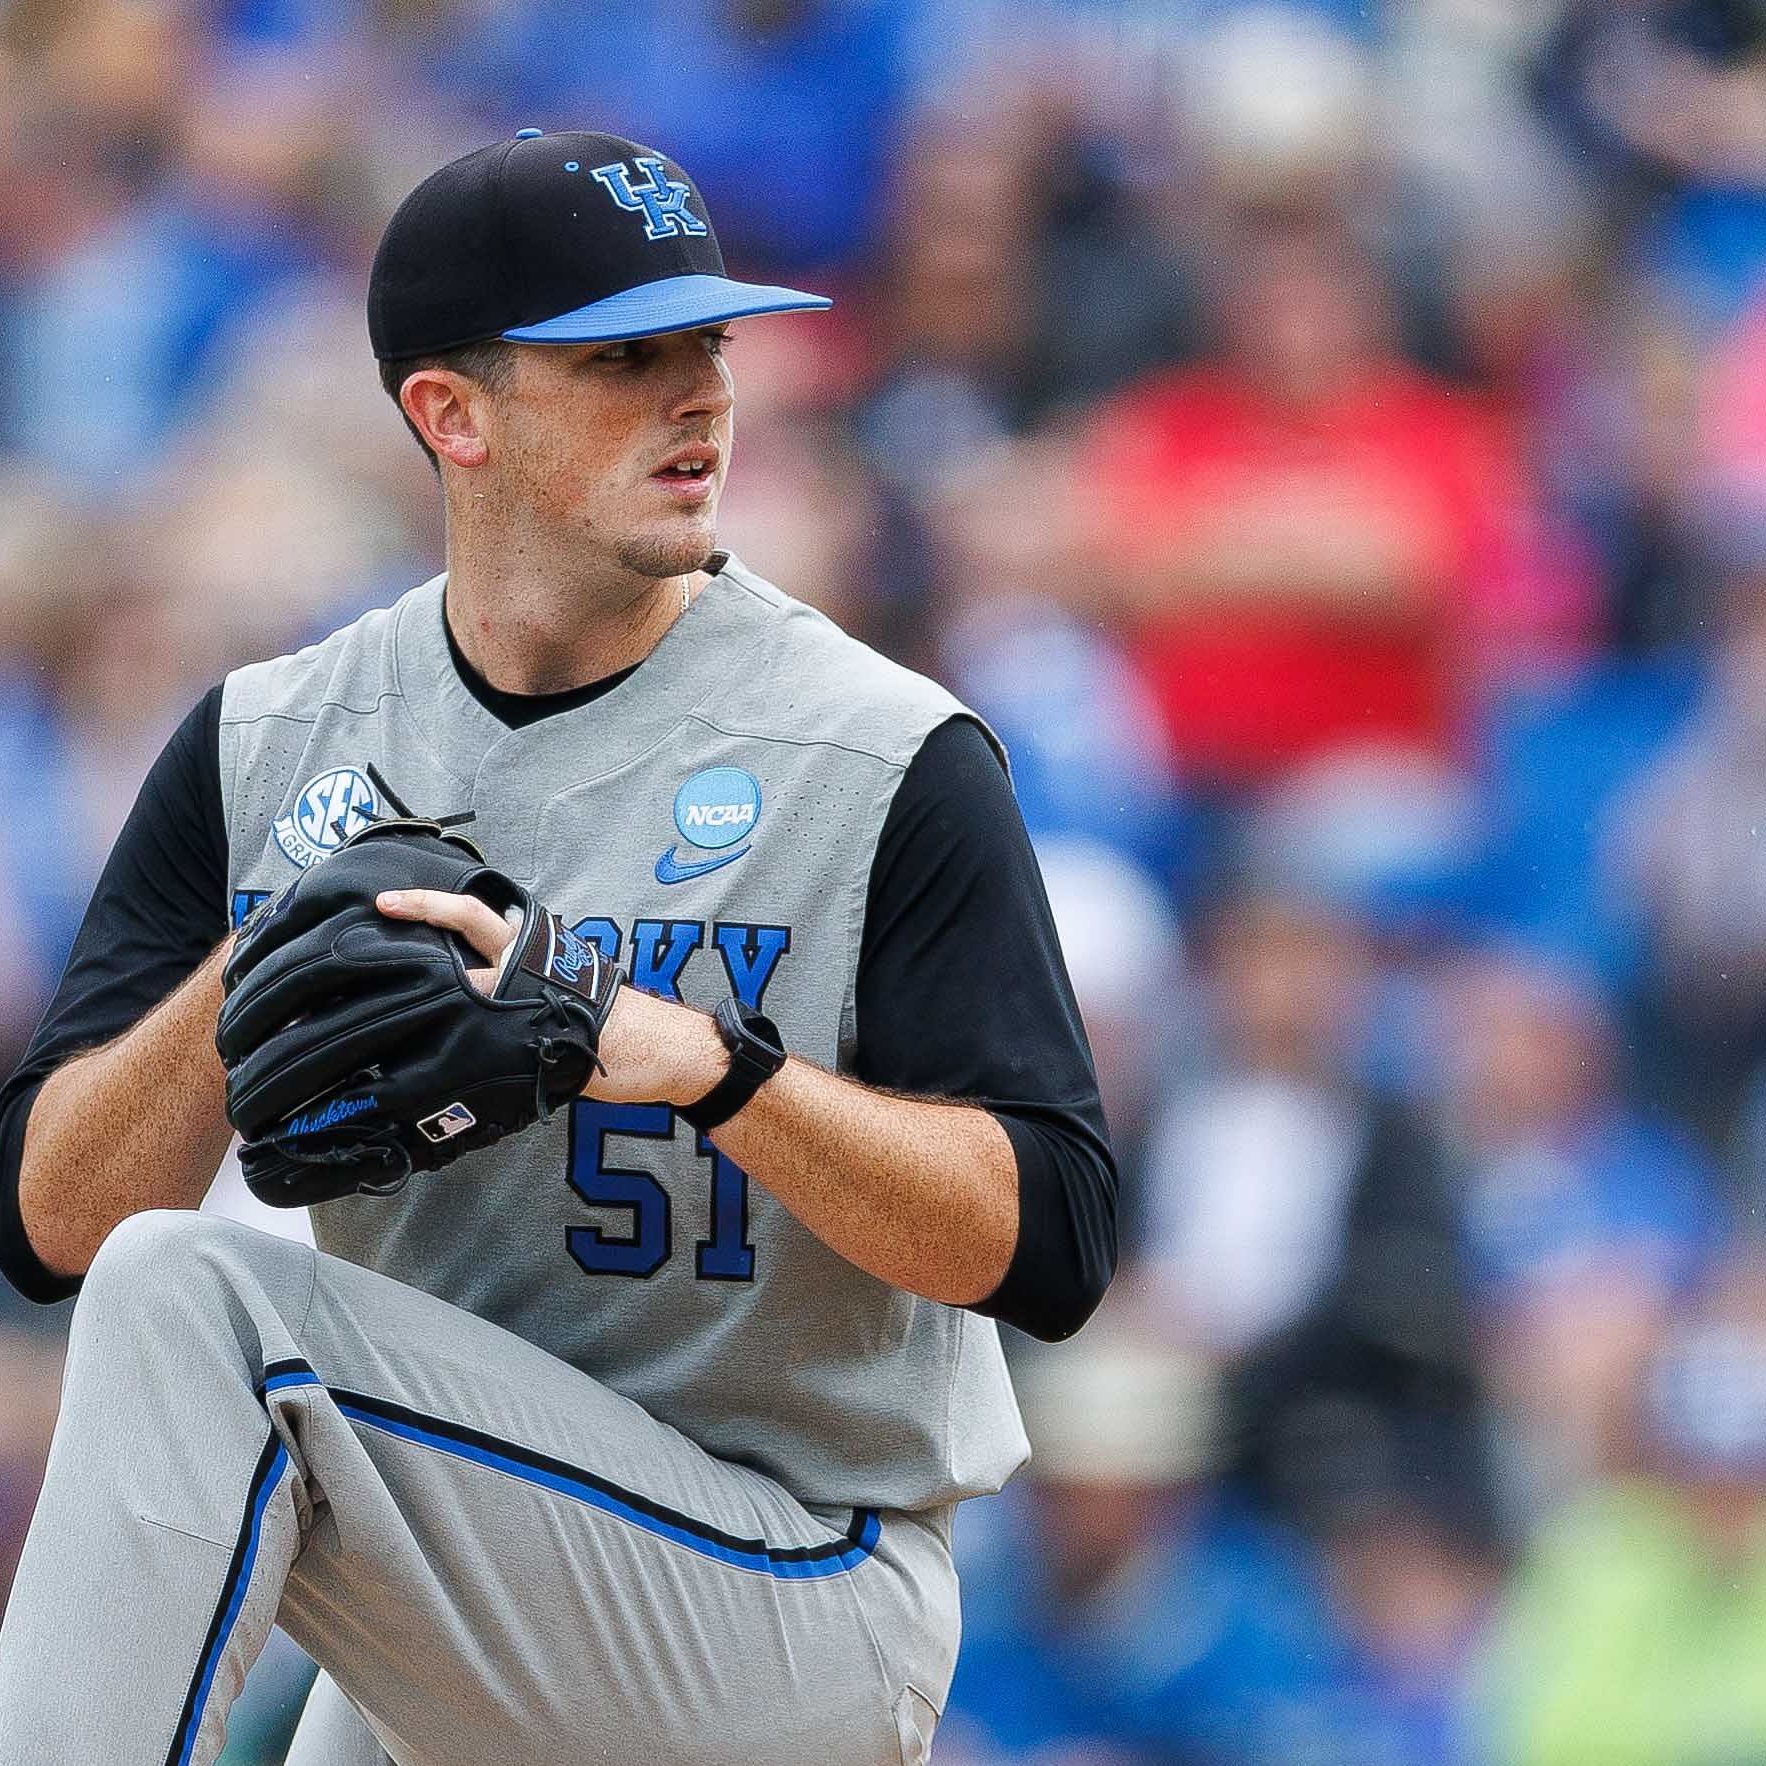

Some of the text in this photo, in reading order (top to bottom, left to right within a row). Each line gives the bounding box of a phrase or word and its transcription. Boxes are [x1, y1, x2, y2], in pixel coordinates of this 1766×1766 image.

[590, 157, 707, 240] UK
[299, 770, 374, 848] SEC
[685, 803, 754, 827] NCAA
[565, 1097, 755, 1282] 51
